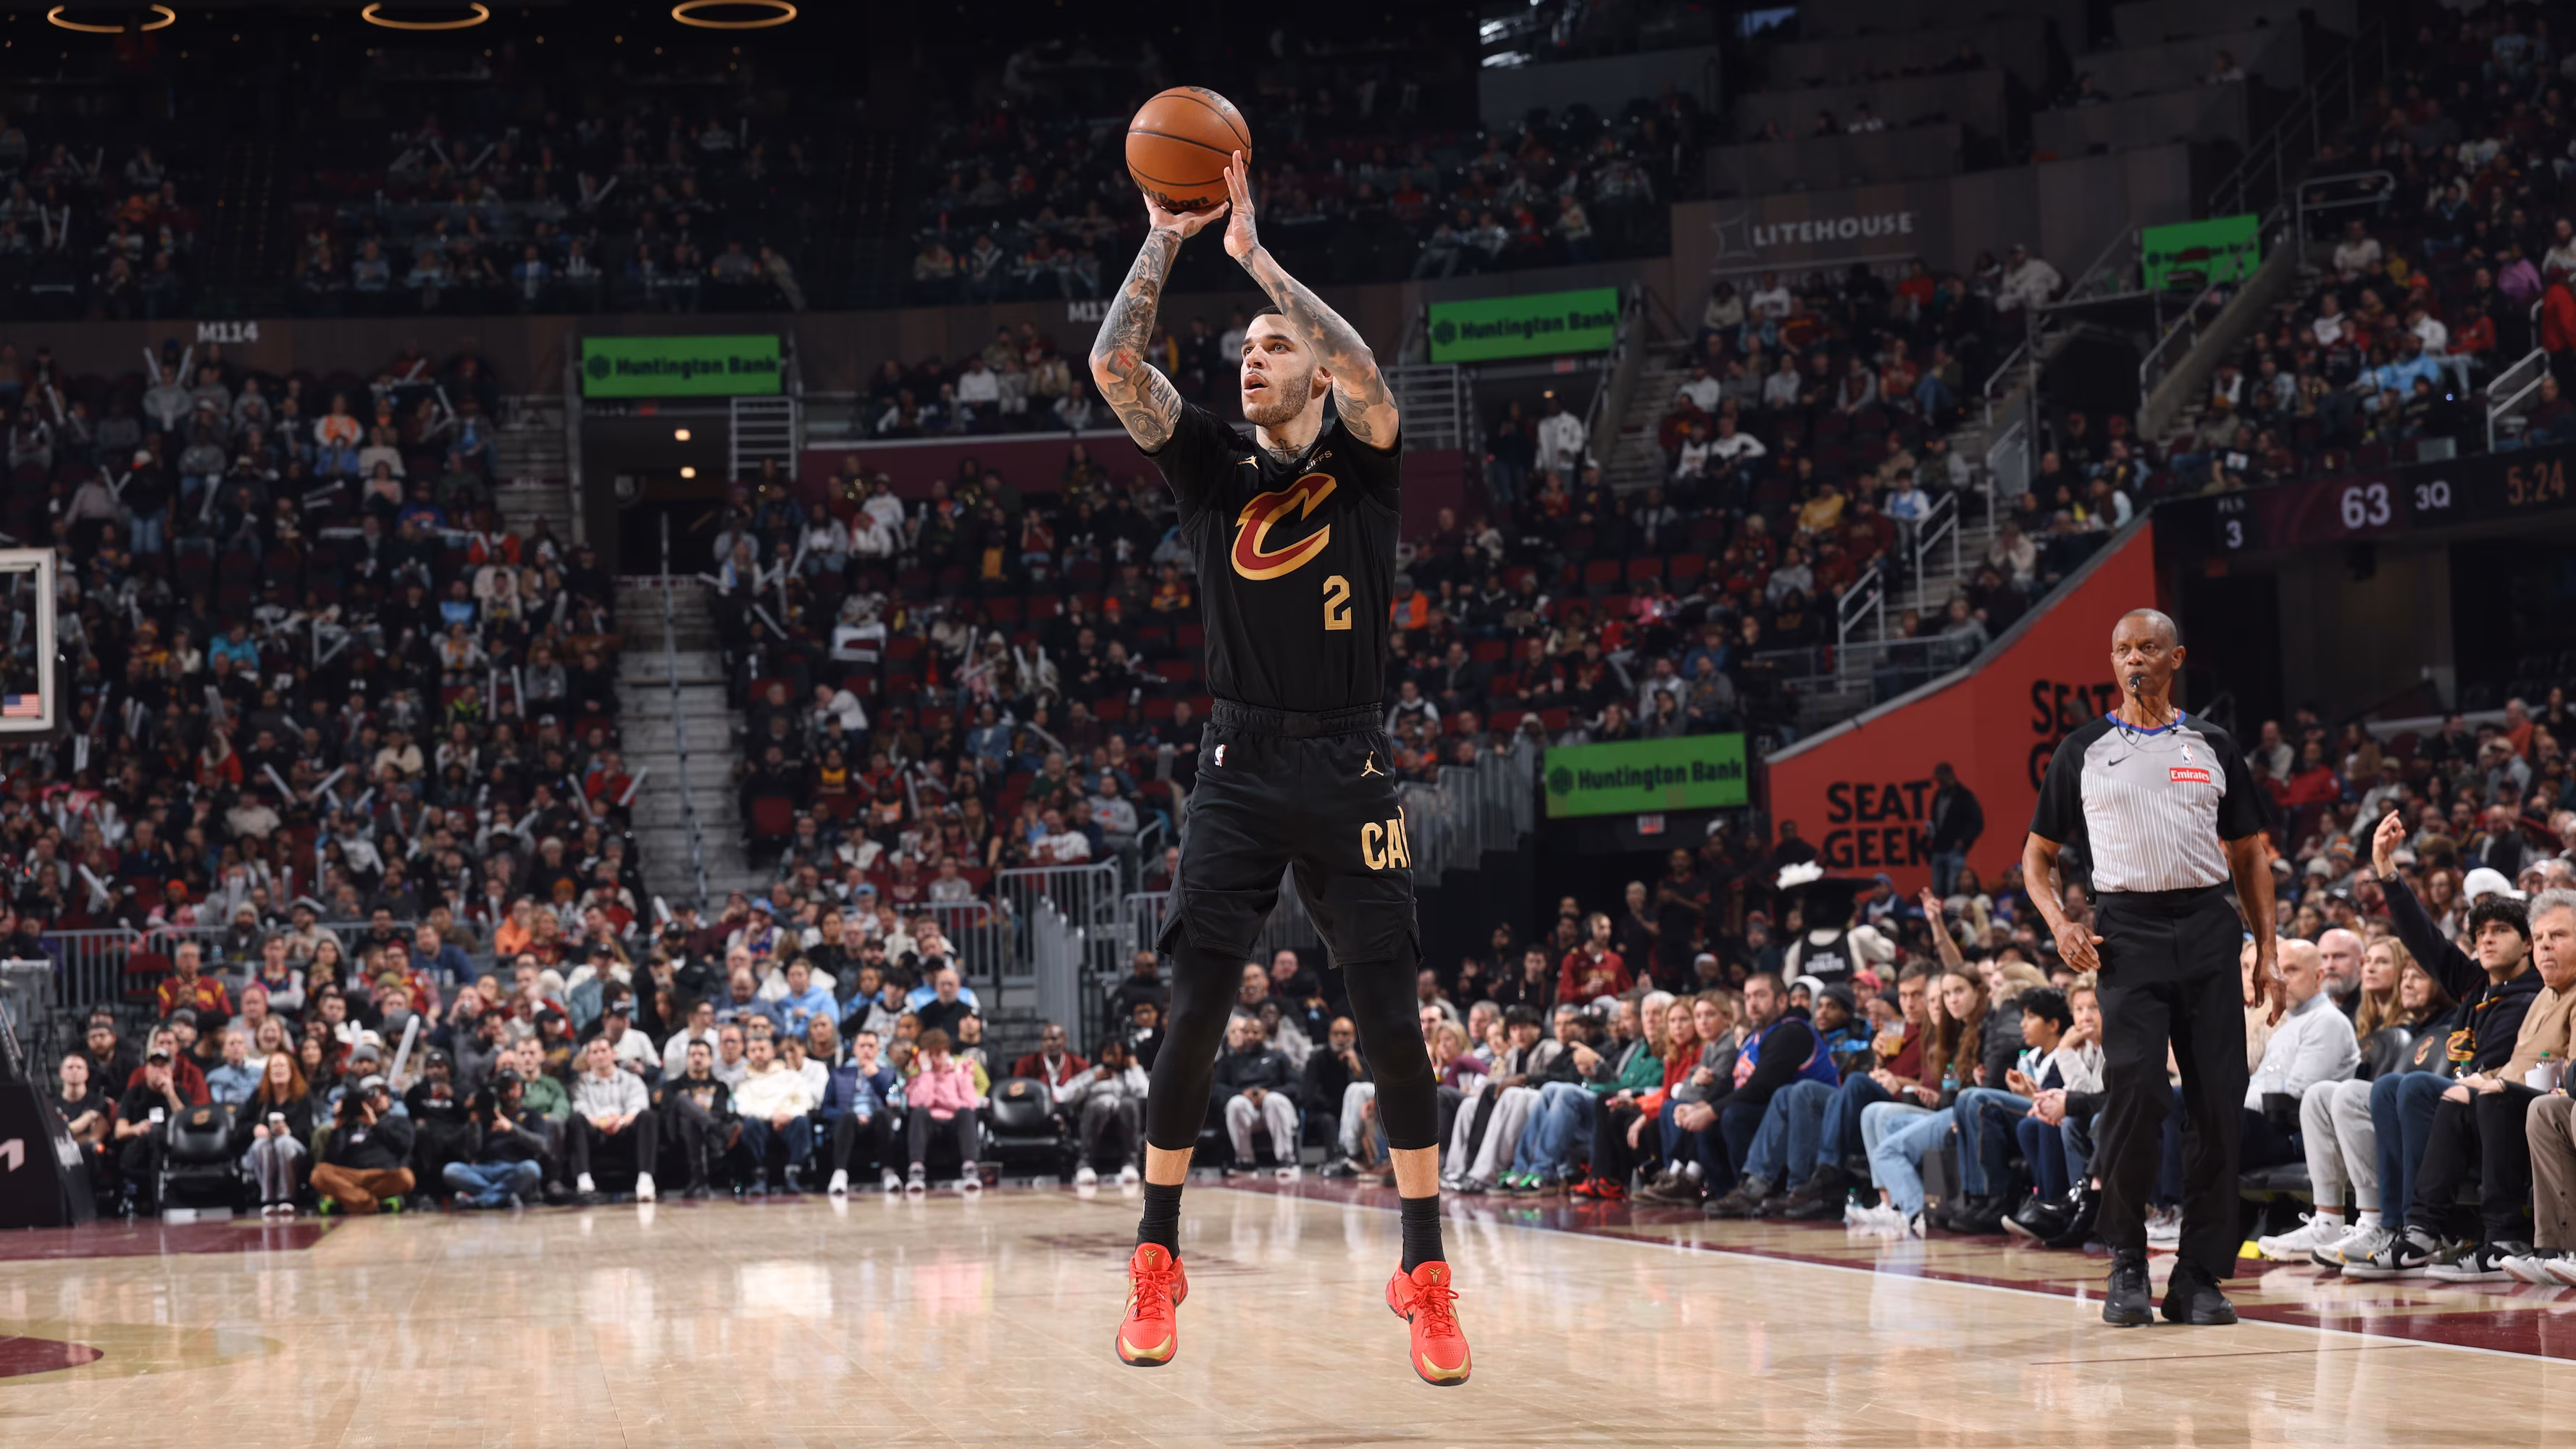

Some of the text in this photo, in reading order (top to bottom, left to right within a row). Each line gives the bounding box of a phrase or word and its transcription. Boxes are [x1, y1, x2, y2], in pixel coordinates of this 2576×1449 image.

[1754, 211, 1913, 246] LITEHOUSE
[197, 321, 259, 343] M114
[1461, 309, 1615, 339] Huntington Bank
[616, 355, 777, 379] Huntington Bank
[1299, 450, 1333, 475] CLIFFS
[2414, 480, 2451, 510] 3Q
[2506, 458, 2566, 506] 5:24
[2341, 482, 2391, 530] 63
[2226, 519, 2243, 548] 3
[1323, 575, 1352, 630] 2
[1578, 758, 1741, 792] Huntington Bank
[2170, 769, 2210, 781] Emirates
[1827, 781, 1931, 822] SEAT
[1823, 827, 1931, 867] GEEK
